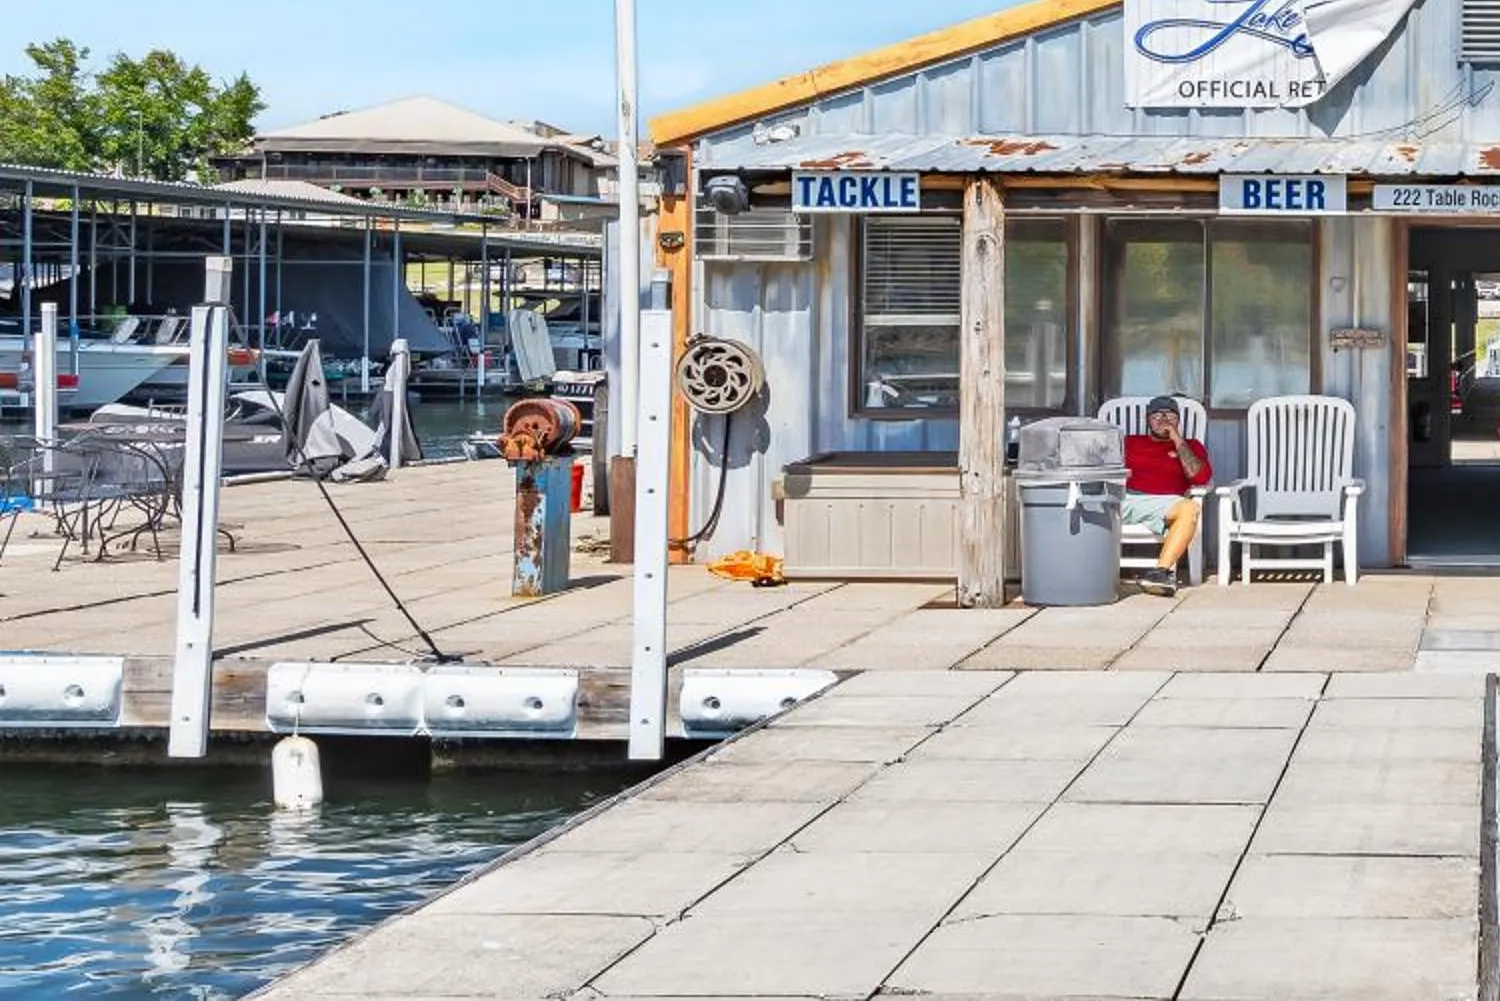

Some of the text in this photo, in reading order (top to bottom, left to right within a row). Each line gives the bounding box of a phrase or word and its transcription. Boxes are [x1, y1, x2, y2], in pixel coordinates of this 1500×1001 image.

[1179, 80, 1280, 99] OFFICIAL
[797, 176, 918, 208] TACKLE
[1242, 178, 1326, 210] BEER
[1393, 188, 1421, 206] 222
[1425, 188, 1466, 206] Table
